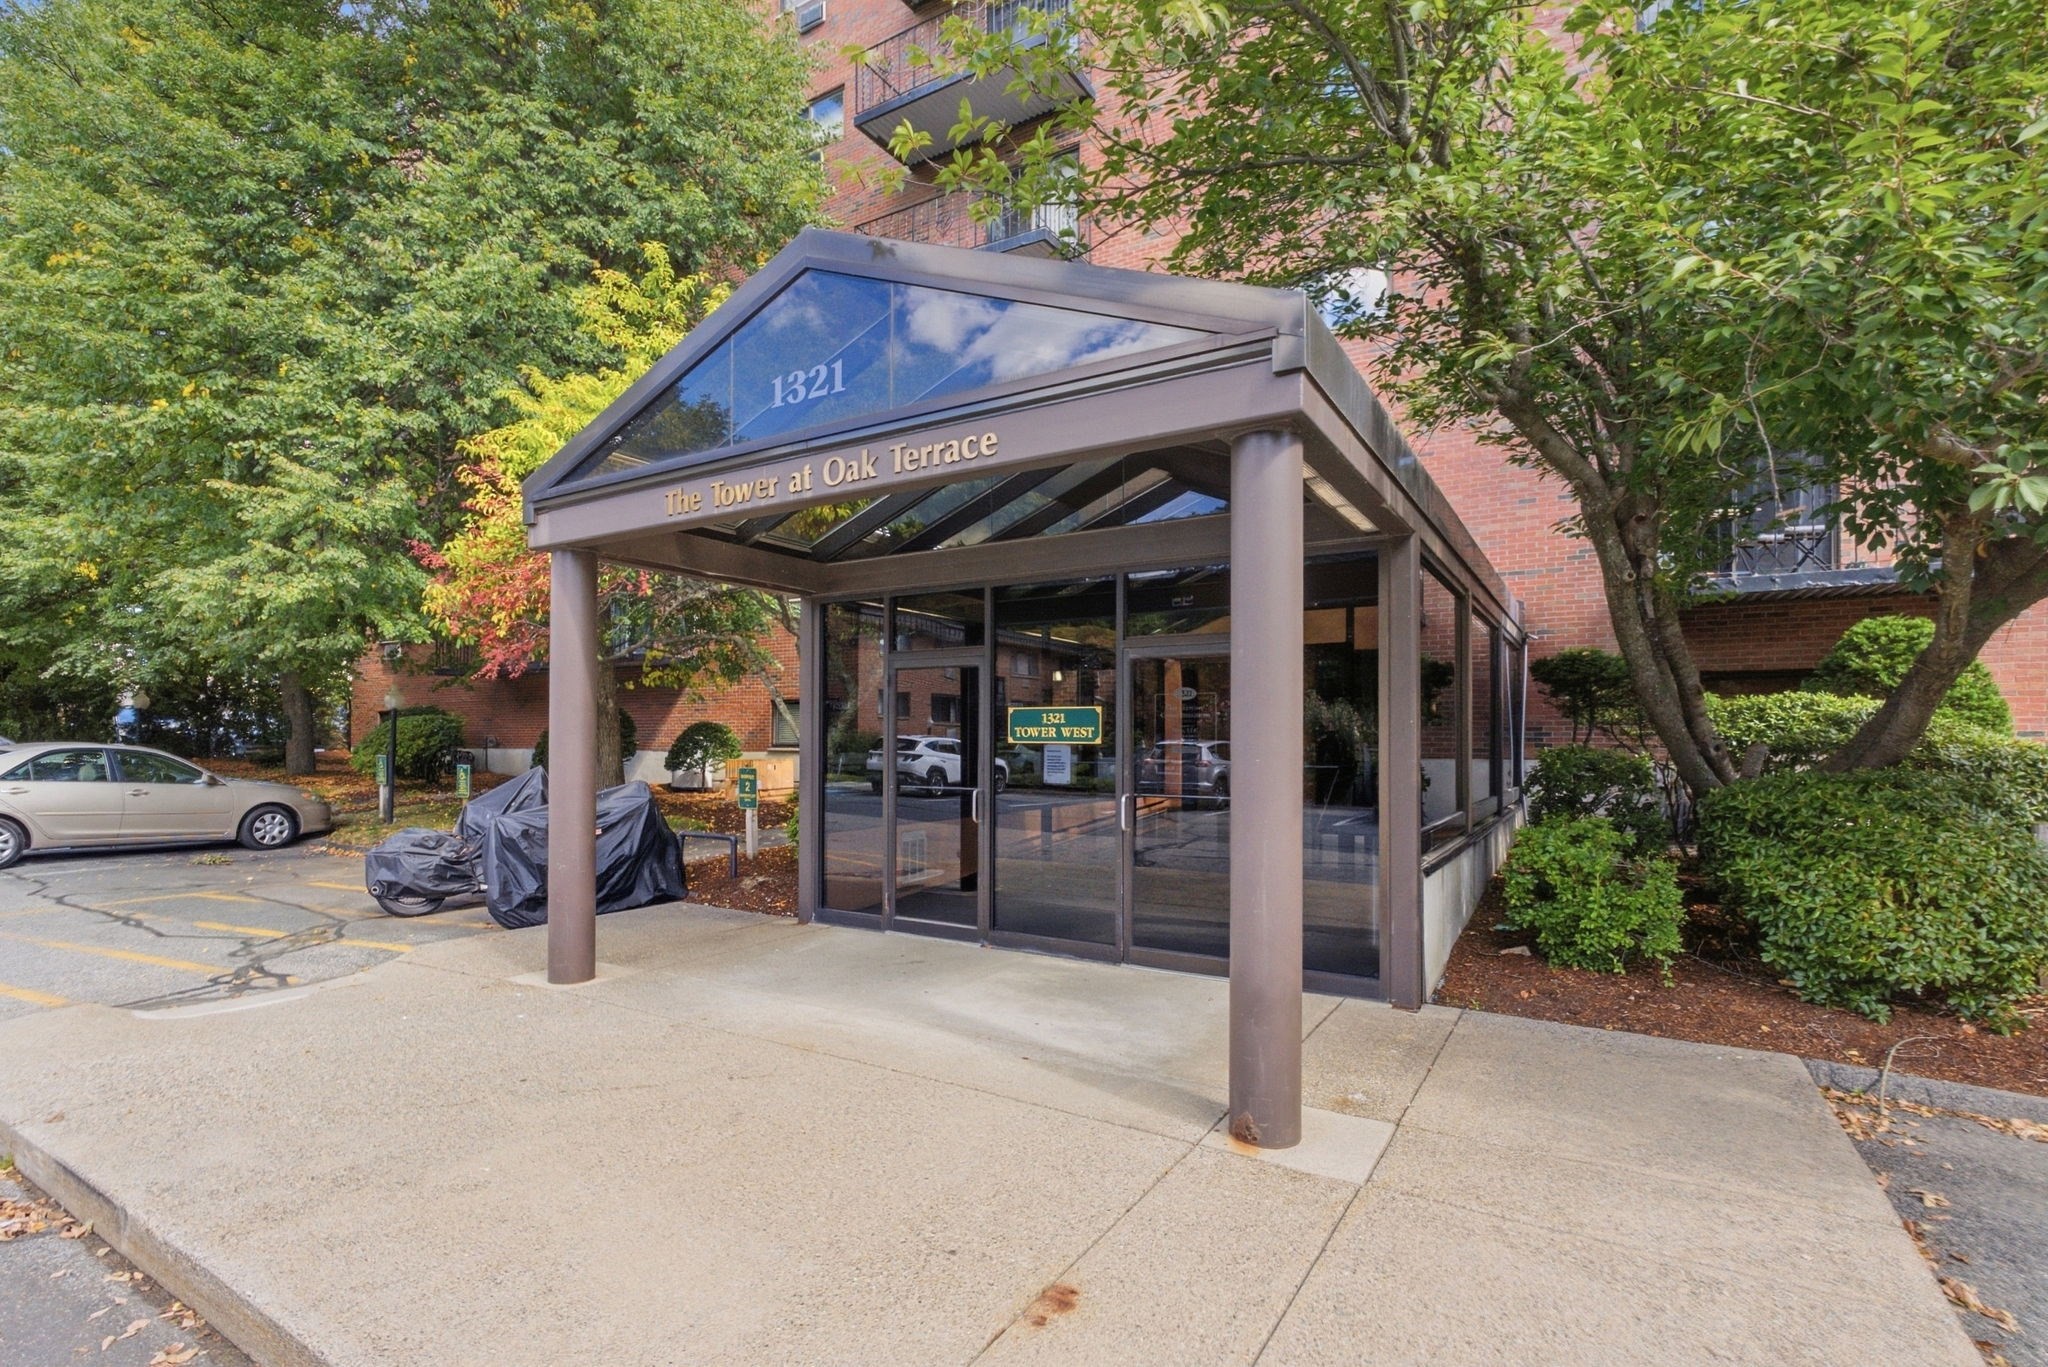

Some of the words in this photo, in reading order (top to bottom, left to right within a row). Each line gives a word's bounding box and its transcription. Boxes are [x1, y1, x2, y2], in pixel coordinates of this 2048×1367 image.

[771, 358, 846, 409] 1321
[665, 487, 702, 517] The
[710, 475, 780, 508] Tower
[788, 463, 813, 495] at
[822, 448, 879, 488] Oak
[890, 432, 999, 474] Terrace
[1041, 713, 1066, 725] 1321
[1014, 727, 1057, 738] TOWER
[1061, 727, 1095, 738] WEST
[745, 781, 751, 792] 2
